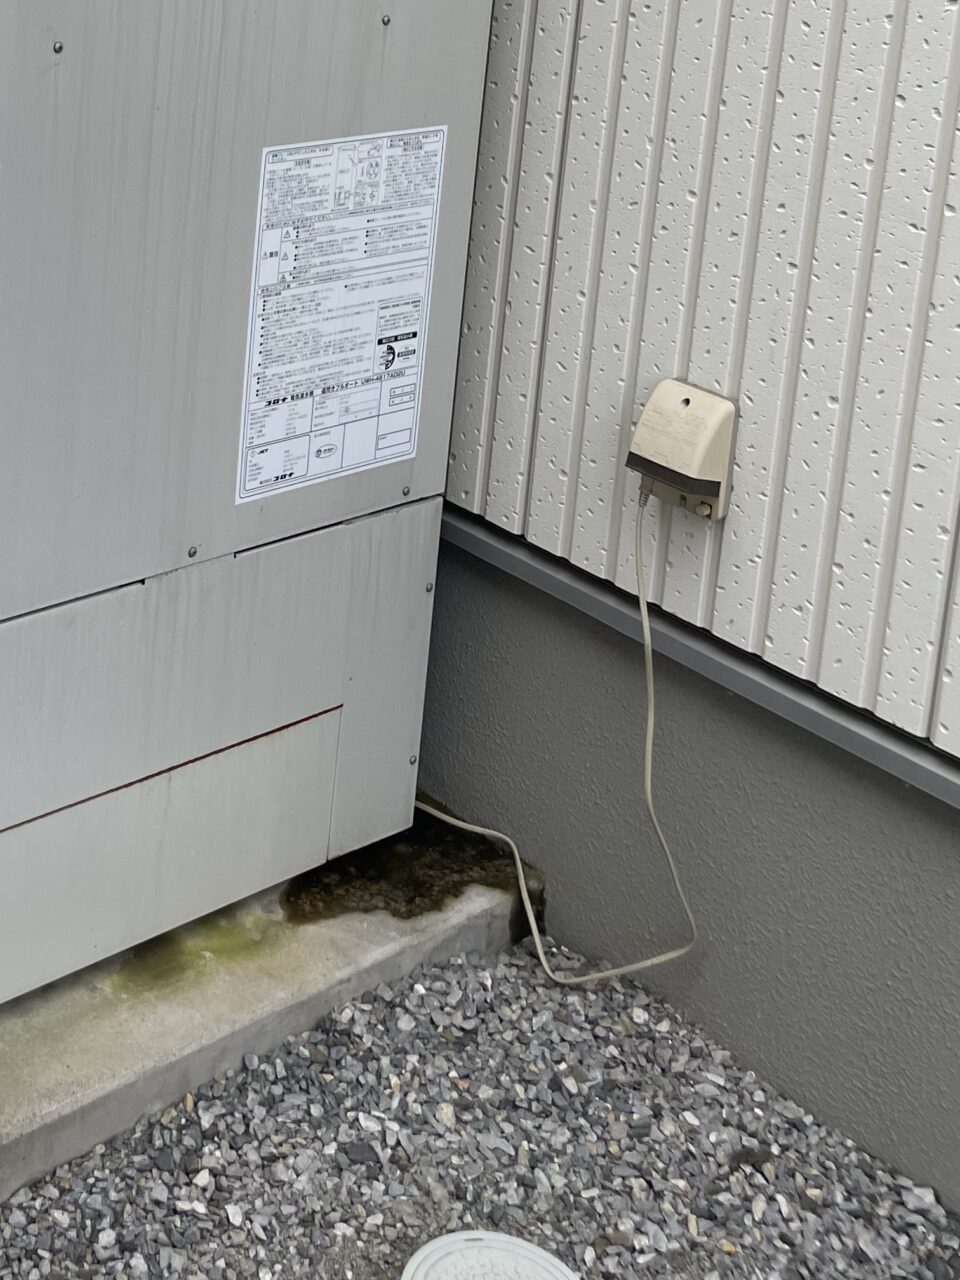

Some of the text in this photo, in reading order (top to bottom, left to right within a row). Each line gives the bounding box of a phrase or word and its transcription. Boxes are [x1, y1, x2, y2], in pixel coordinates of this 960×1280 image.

[264, 397, 288, 407] コロナ
[273, 472, 295, 482] コロナ
